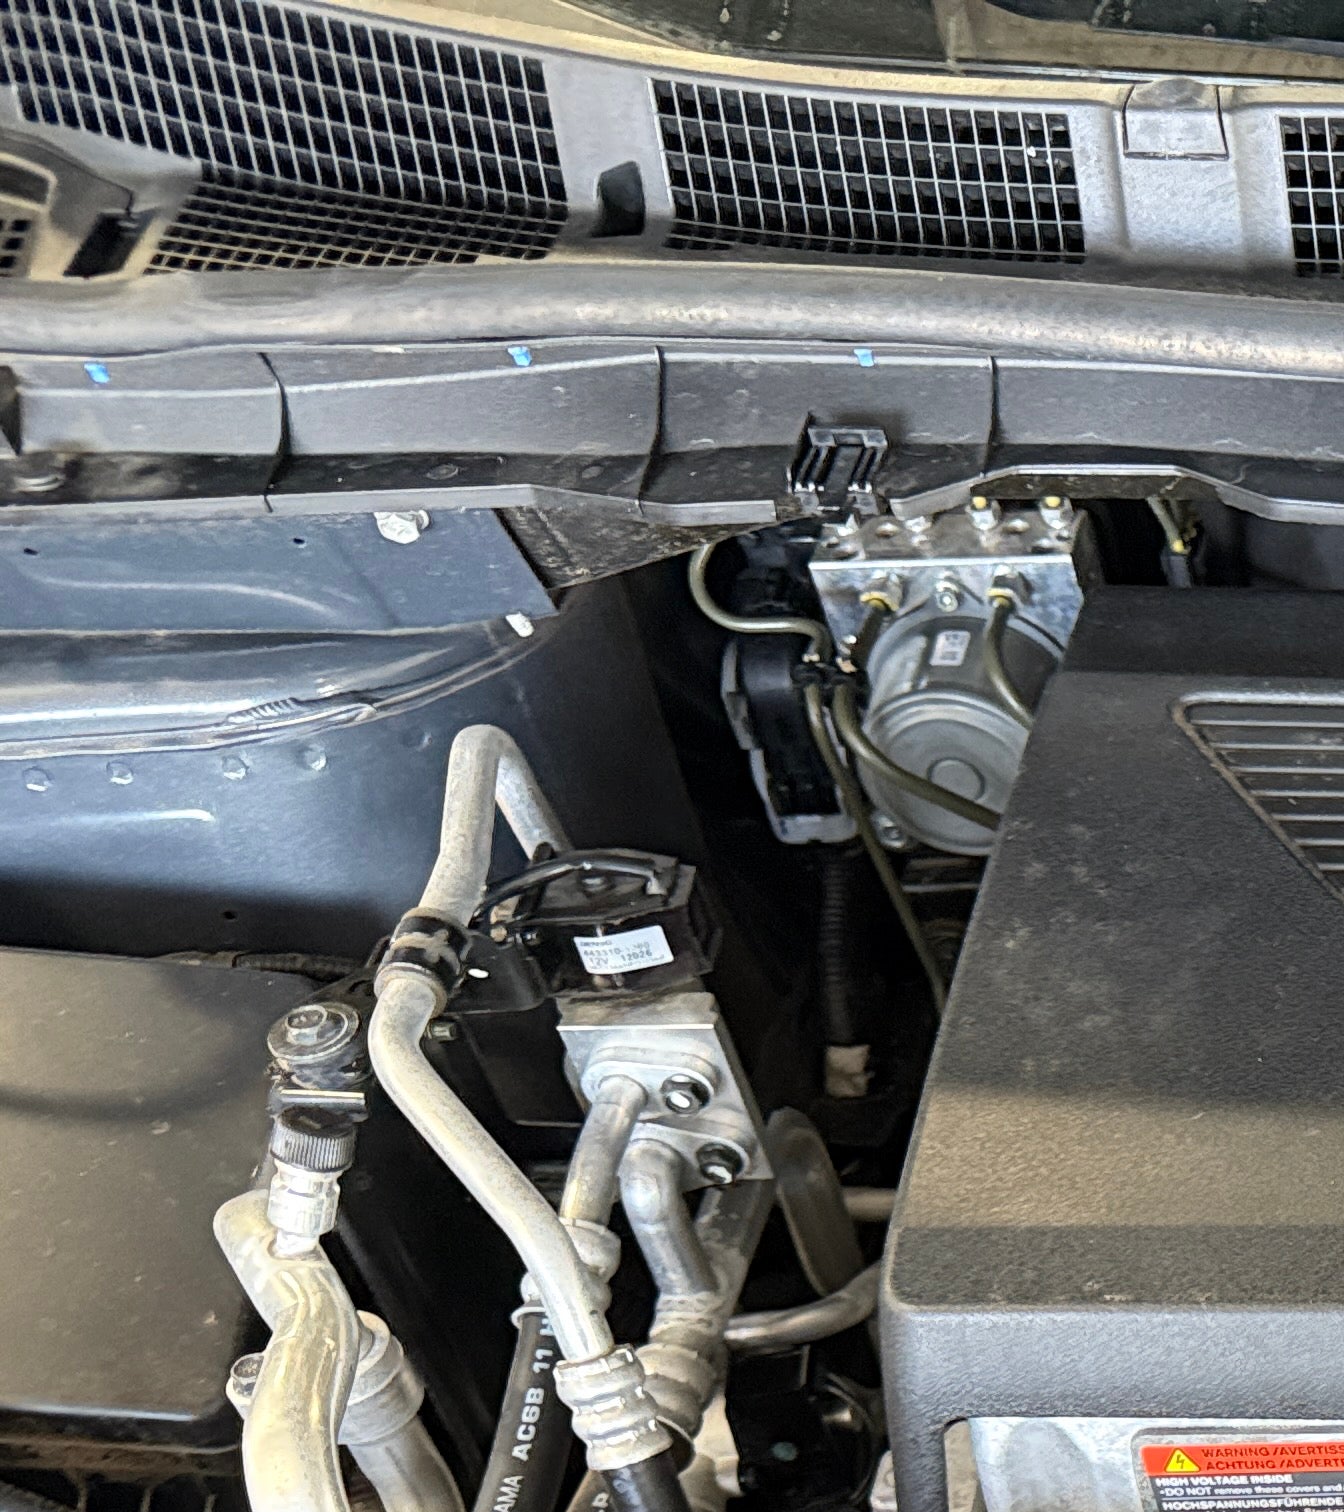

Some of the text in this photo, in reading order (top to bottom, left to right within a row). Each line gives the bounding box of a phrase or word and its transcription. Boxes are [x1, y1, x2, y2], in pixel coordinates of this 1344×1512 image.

[512, 1386, 545, 1462] AC6B
[532, 1348, 554, 1374] 11
[1201, 1446, 1270, 1458] WARNING
[1206, 1460, 1276, 1471] ACHTUNG
[1155, 1474, 1293, 1487] HIGH VOLTAGE INSIDE
[1186, 1486, 1212, 1496] NOT
